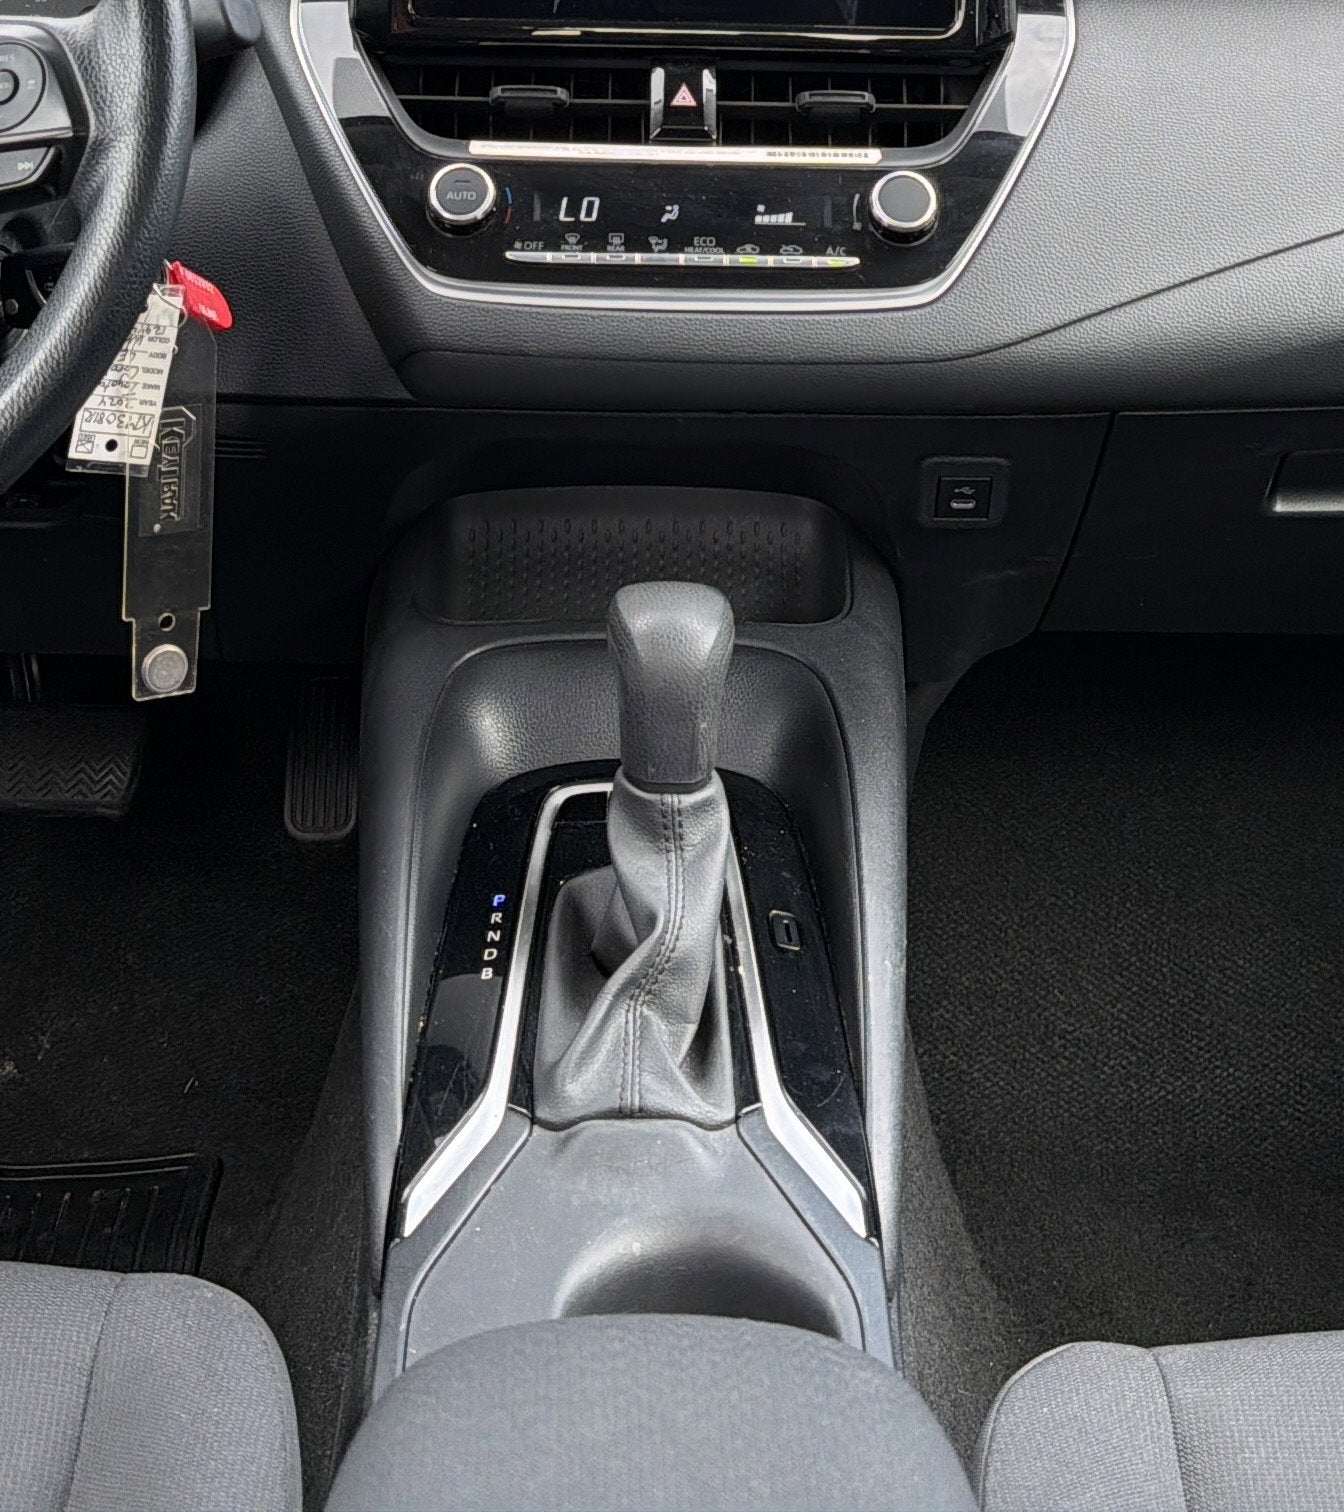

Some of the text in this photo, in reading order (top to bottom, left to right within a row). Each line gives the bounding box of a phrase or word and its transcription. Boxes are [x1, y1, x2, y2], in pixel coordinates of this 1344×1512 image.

[446, 191, 477, 201] AUTO
[559, 196, 600, 222] LO
[524, 241, 545, 250] OFF
[694, 237, 716, 247] ECO
[826, 245, 846, 256] A/C
[147, 336, 171, 344] COLOR
[148, 351, 167, 359] BODY
[141, 367, 164, 375] MODEL
[141, 382, 161, 390] MAKE
[139, 399, 157, 407] YEAR
[492, 894, 506, 907] P
[490, 912, 503, 924] R
[487, 930, 501, 942] N
[484, 948, 498, 961] D
[481, 967, 494, 980] B
